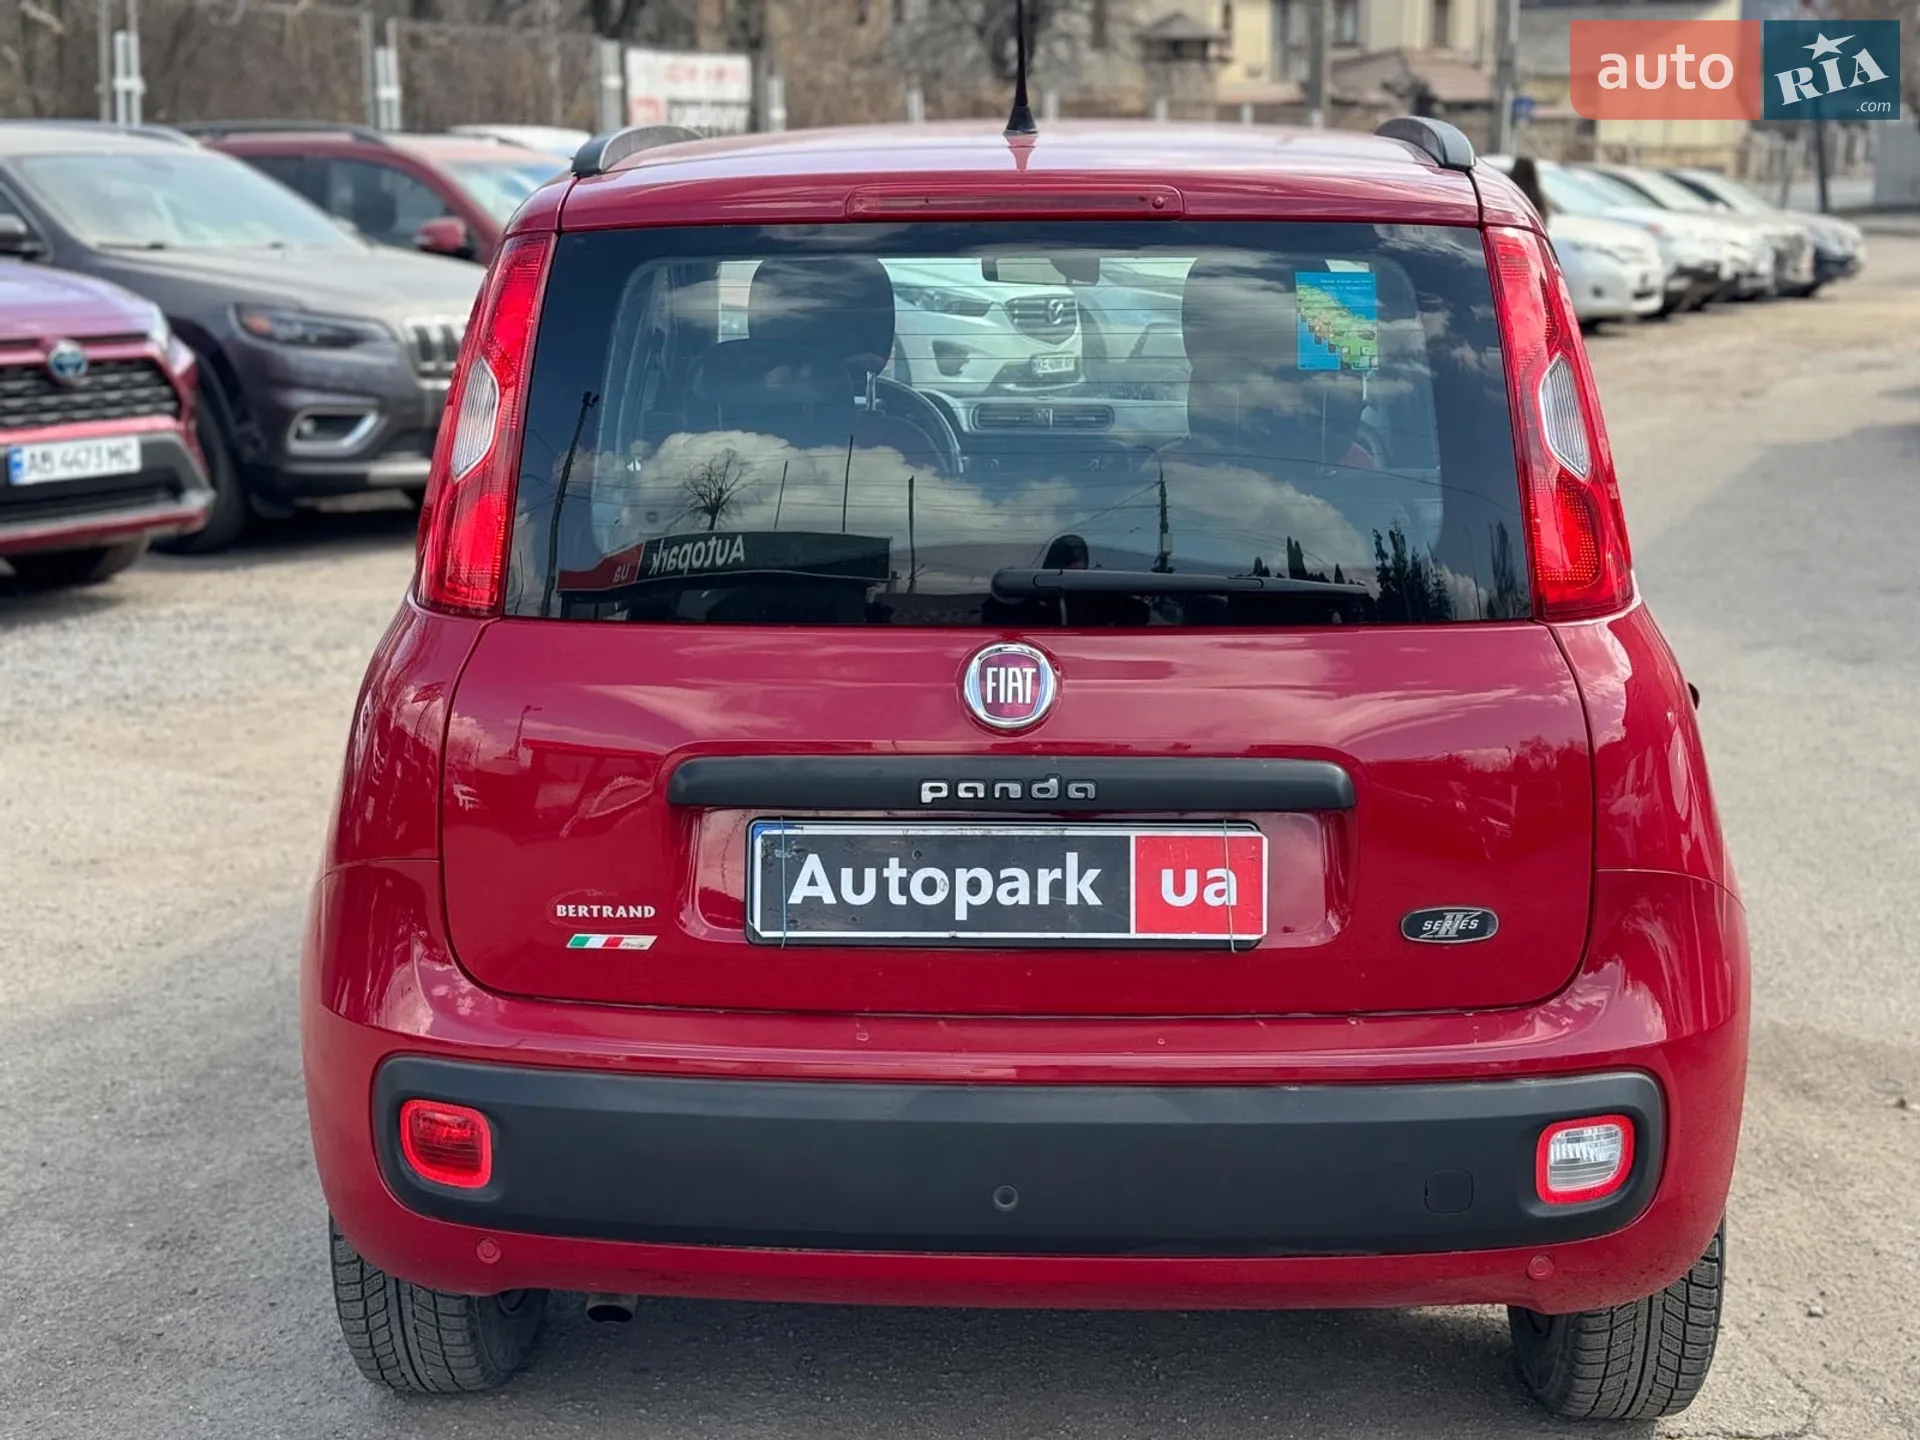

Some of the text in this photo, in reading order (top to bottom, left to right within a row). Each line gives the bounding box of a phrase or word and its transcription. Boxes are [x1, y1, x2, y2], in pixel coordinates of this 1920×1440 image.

[986, 667, 1037, 704] FIAT
[920, 777, 1097, 804] panda
[787, 852, 1239, 921] Autopark ua
[556, 904, 656, 918] BERTRAND
[1422, 919, 1480, 931] SERIES
